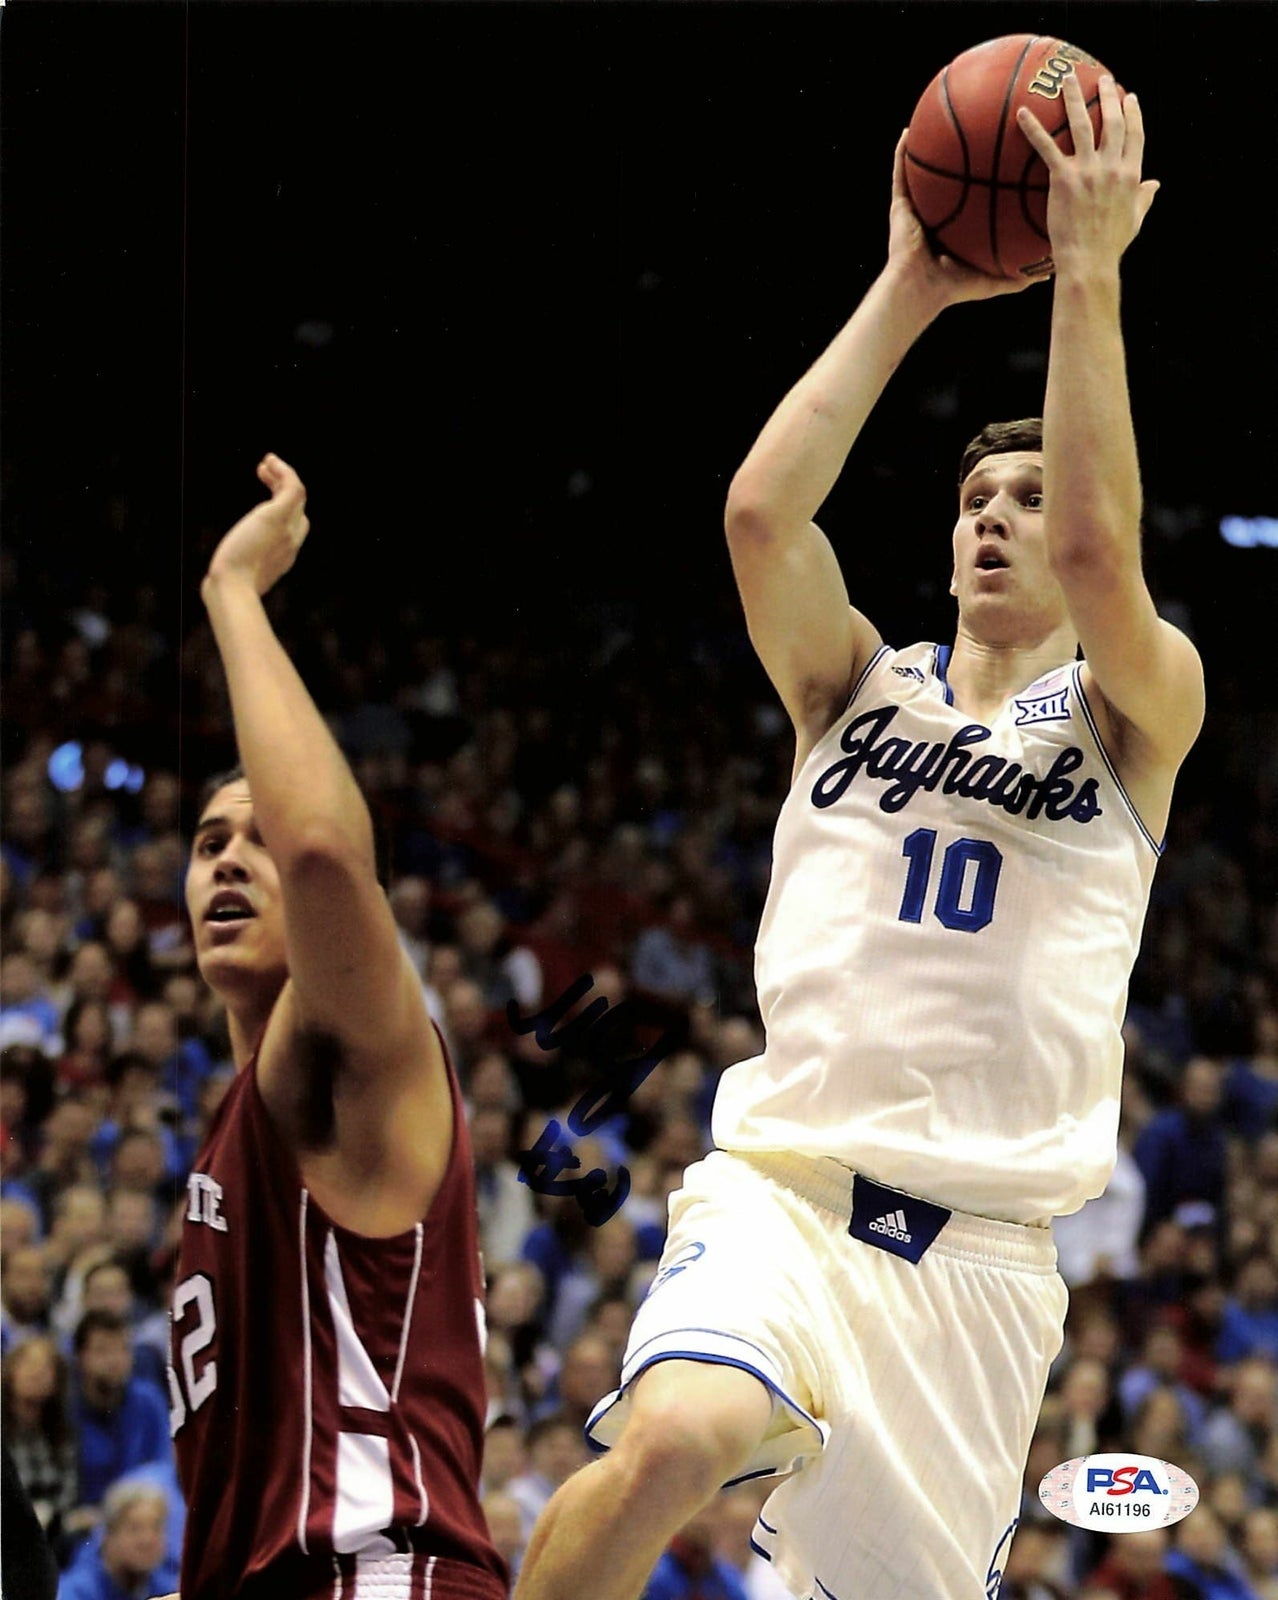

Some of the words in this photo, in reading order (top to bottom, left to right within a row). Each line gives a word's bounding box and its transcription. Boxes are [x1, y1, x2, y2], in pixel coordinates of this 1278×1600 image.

[810, 705, 1102, 824] Jayhawks
[898, 827, 1003, 933] 10
[868, 1221, 912, 1243] adidas
[166, 1273, 217, 1439] 2
